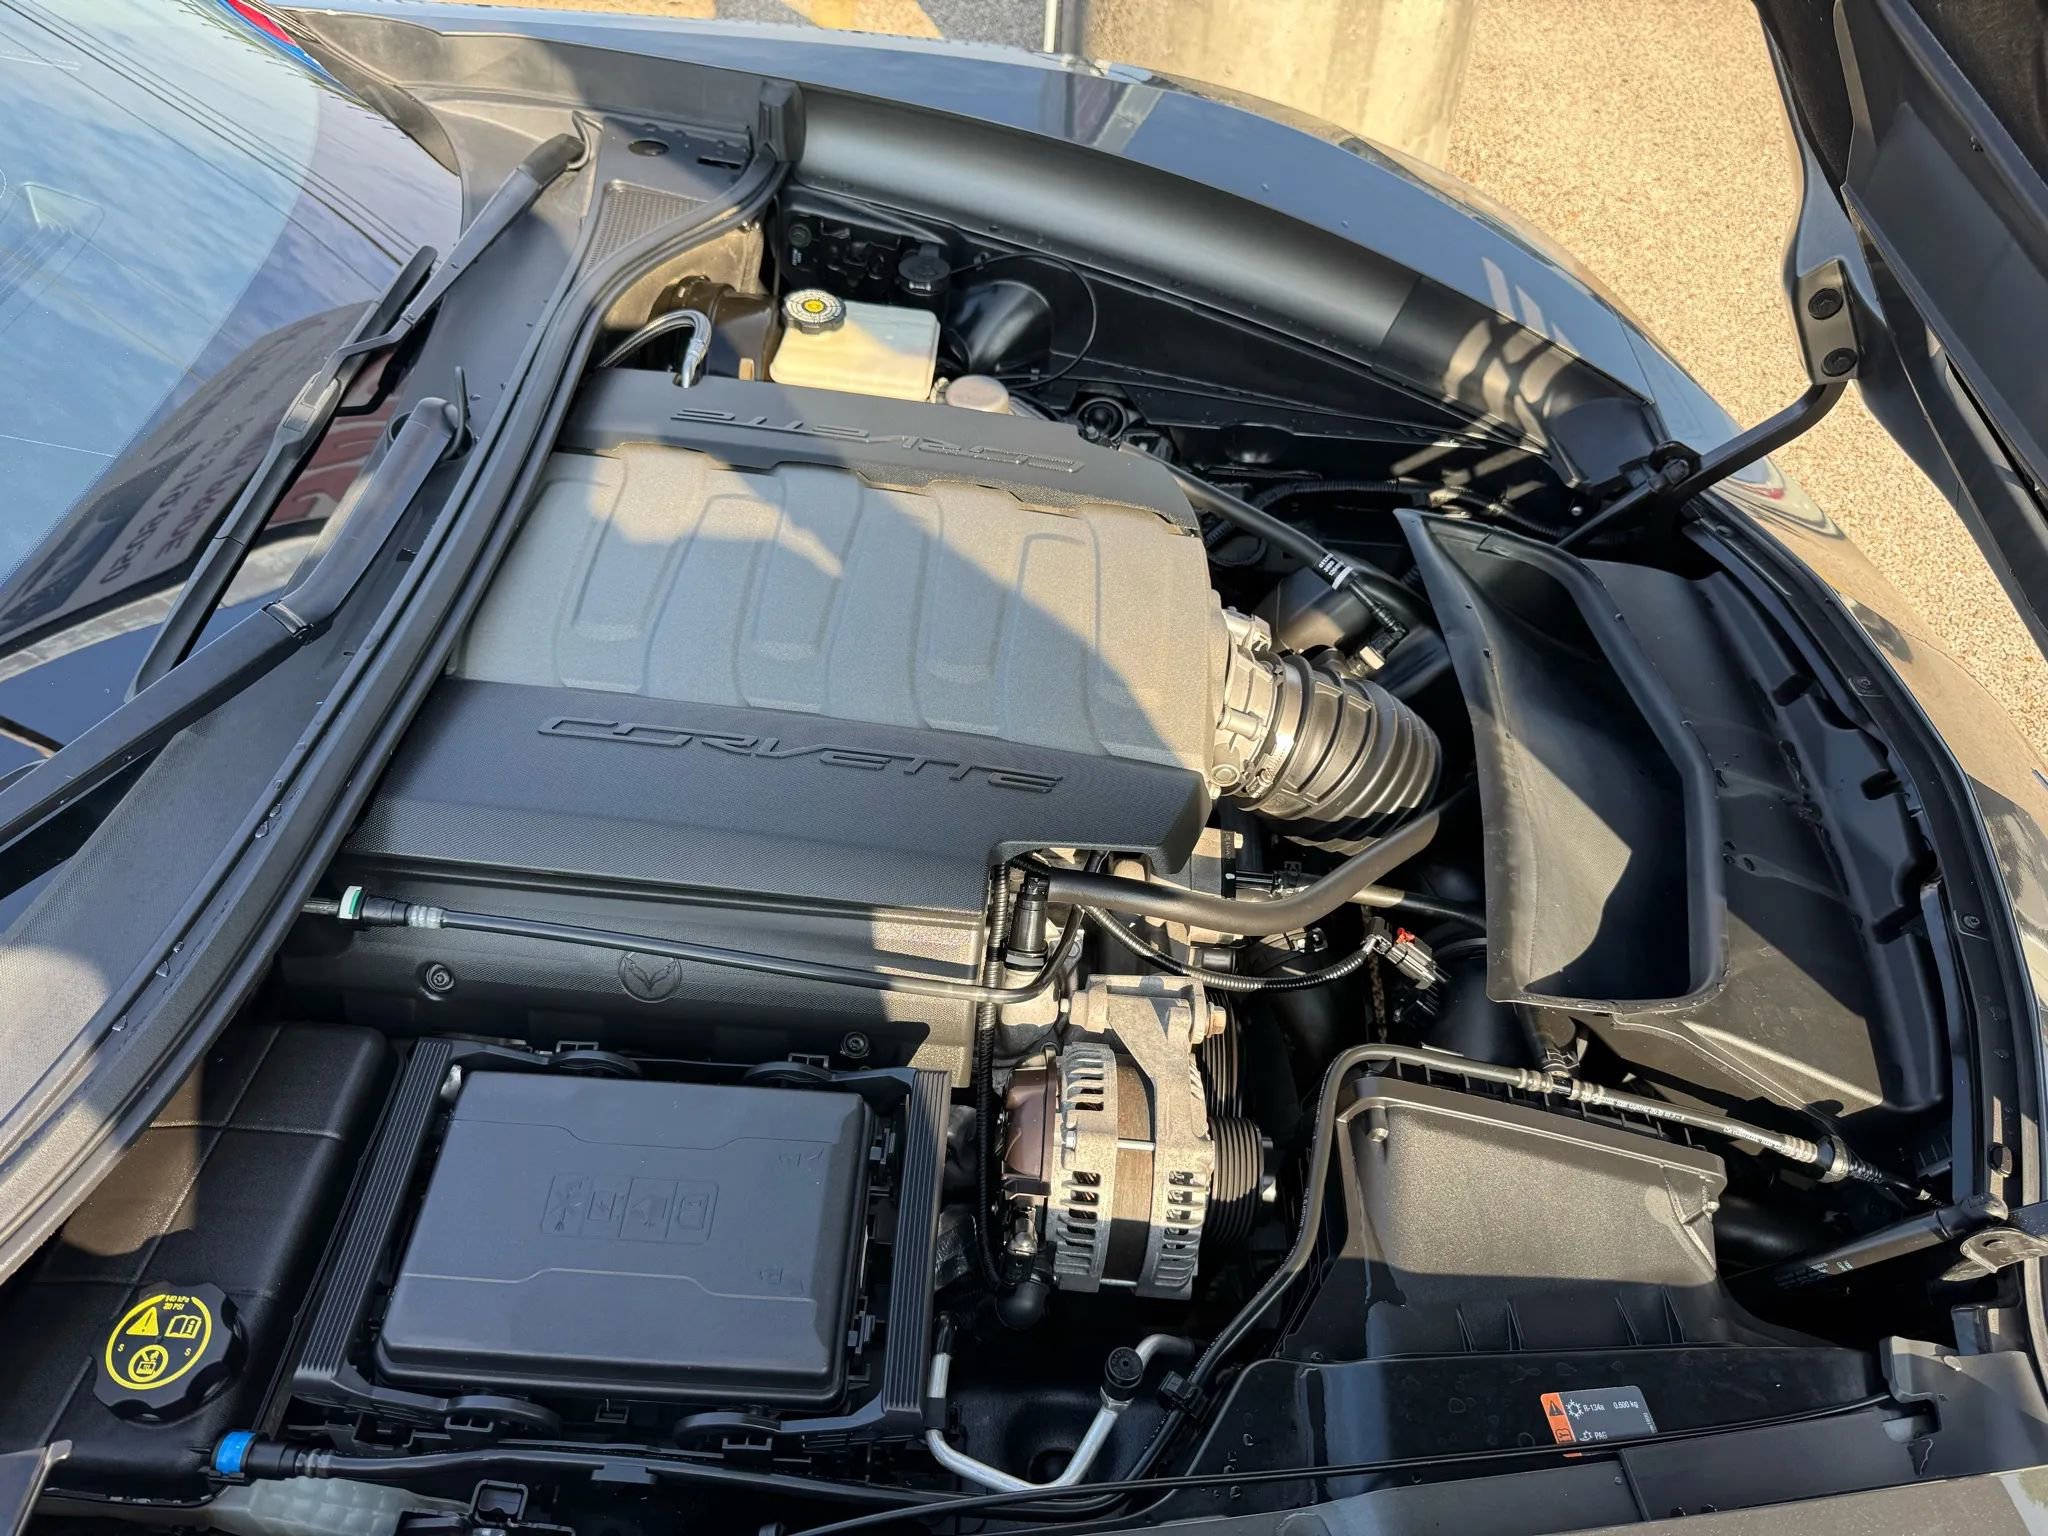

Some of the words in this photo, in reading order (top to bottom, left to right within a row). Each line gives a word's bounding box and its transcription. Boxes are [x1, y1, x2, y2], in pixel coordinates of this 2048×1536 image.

[669, 407, 1086, 473] CORVETTE
[537, 716, 1064, 794] CORVETTE
[1583, 1403, 1605, 1412] R-134a
[1630, 1400, 1639, 1409] kg
[1594, 1431, 1608, 1440] PAG
